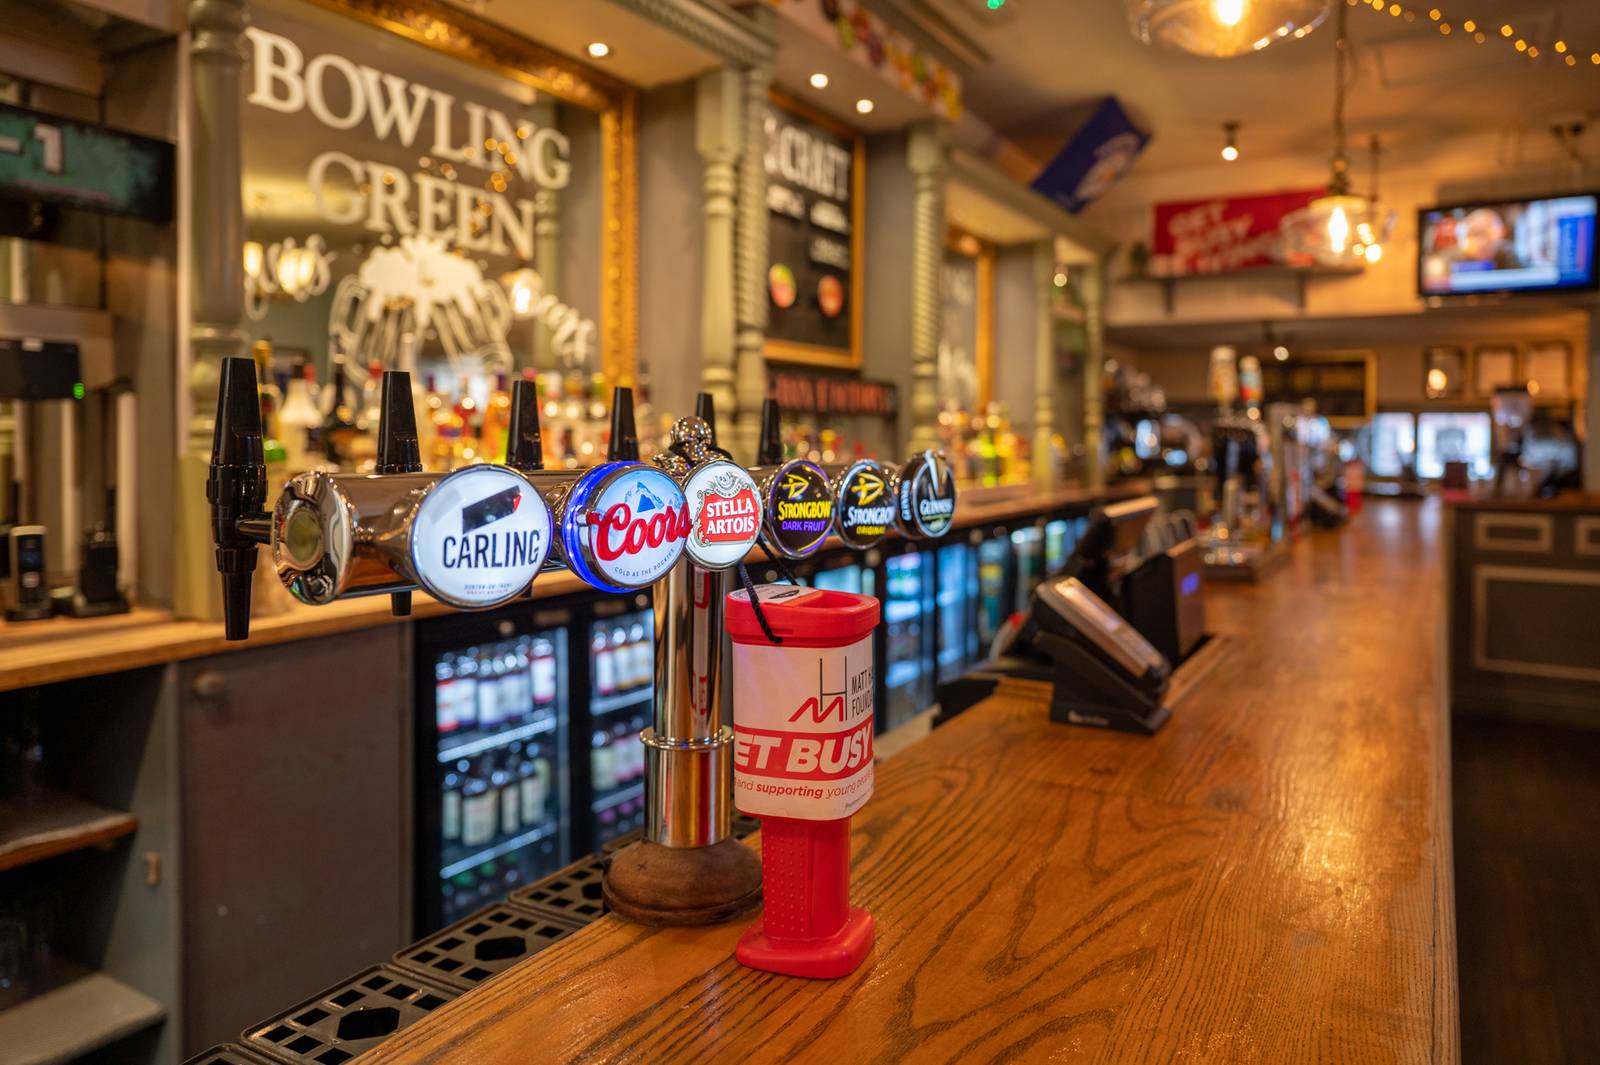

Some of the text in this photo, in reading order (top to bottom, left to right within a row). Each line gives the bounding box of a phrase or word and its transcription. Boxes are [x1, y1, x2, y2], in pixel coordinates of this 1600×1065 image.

[245, 26, 571, 189] BOWLING
[307, 152, 536, 260] GREEN
[706, 498, 754, 517] STELLA
[778, 500, 831, 520] STRONGBOW
[586, 502, 693, 561] Coors
[706, 516, 754, 534] ARTOIS
[782, 520, 826, 531] DARK FRUIT
[443, 529, 540, 569] CARLING
[614, 566, 630, 577] COLD
[641, 568, 652, 577] THE
[852, 669, 867, 695] MATT
[786, 721, 872, 774] BUSY
[737, 780, 754, 791] and
[756, 783, 824, 799] supporting
[827, 781, 856, 799] young
